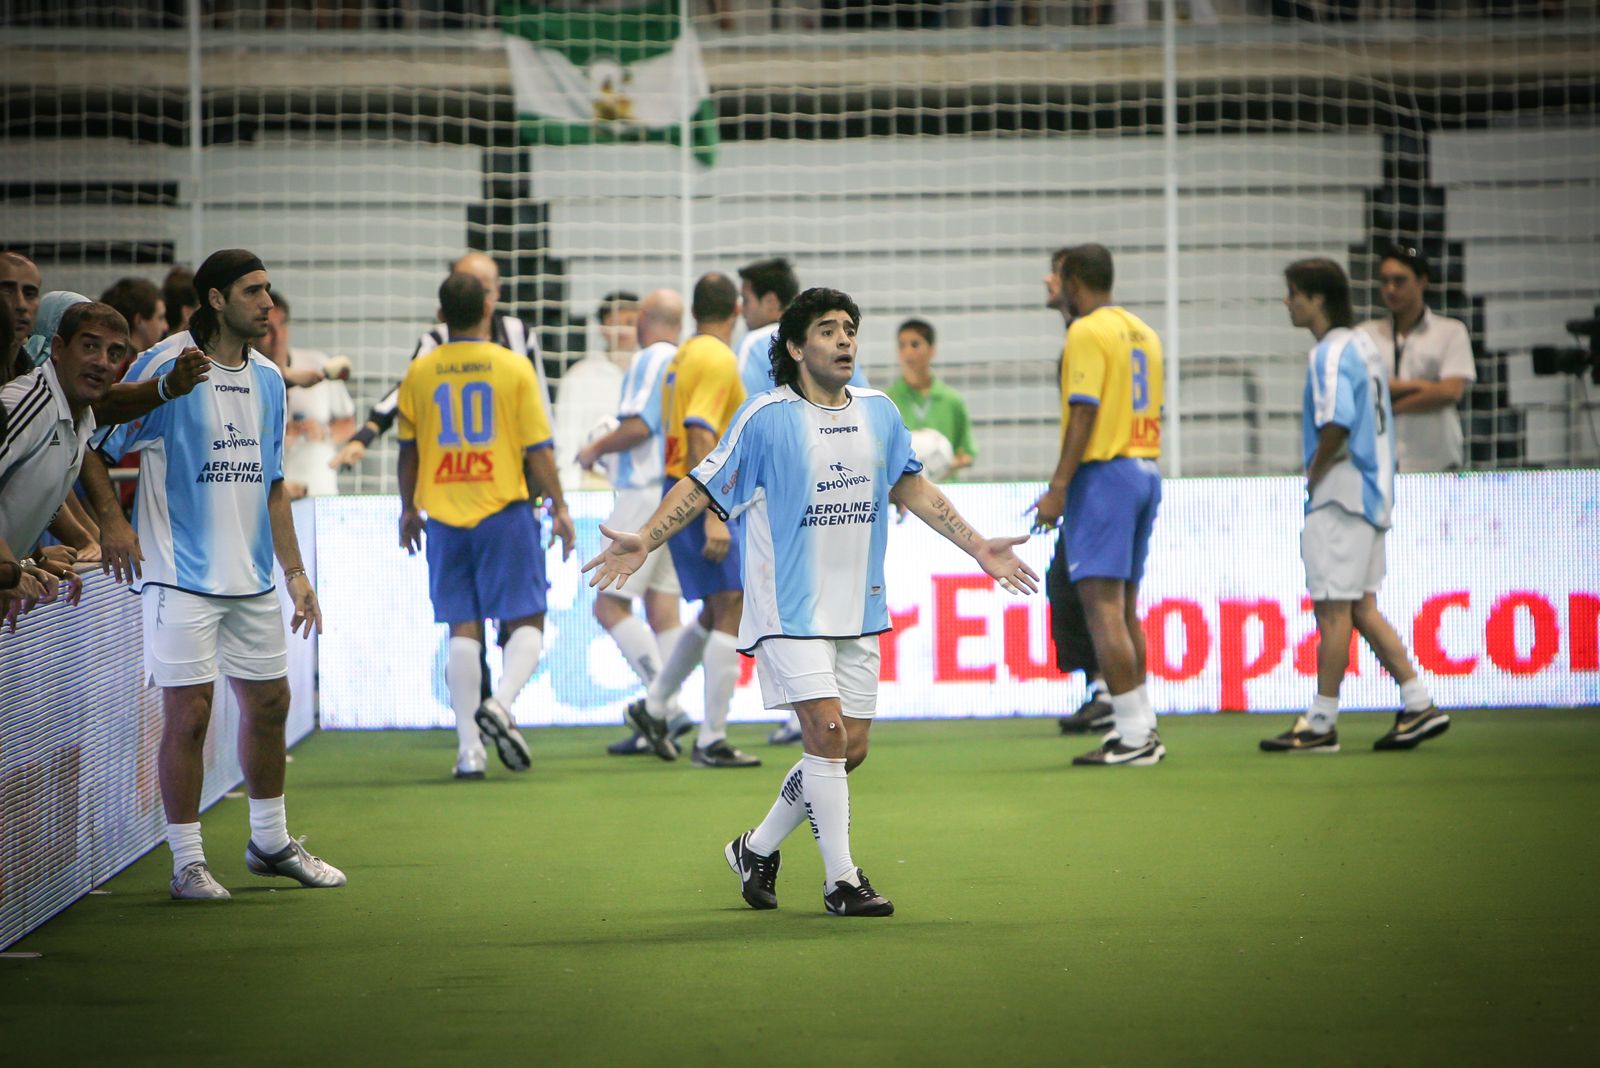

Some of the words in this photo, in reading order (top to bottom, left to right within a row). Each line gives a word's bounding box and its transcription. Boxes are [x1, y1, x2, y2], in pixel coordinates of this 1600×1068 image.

[214, 384, 250, 394] TOPPER
[433, 381, 494, 445] 10
[818, 425, 859, 435] TOPPER
[435, 450, 494, 476] ALPS
[816, 473, 871, 492] SHOWBOL
